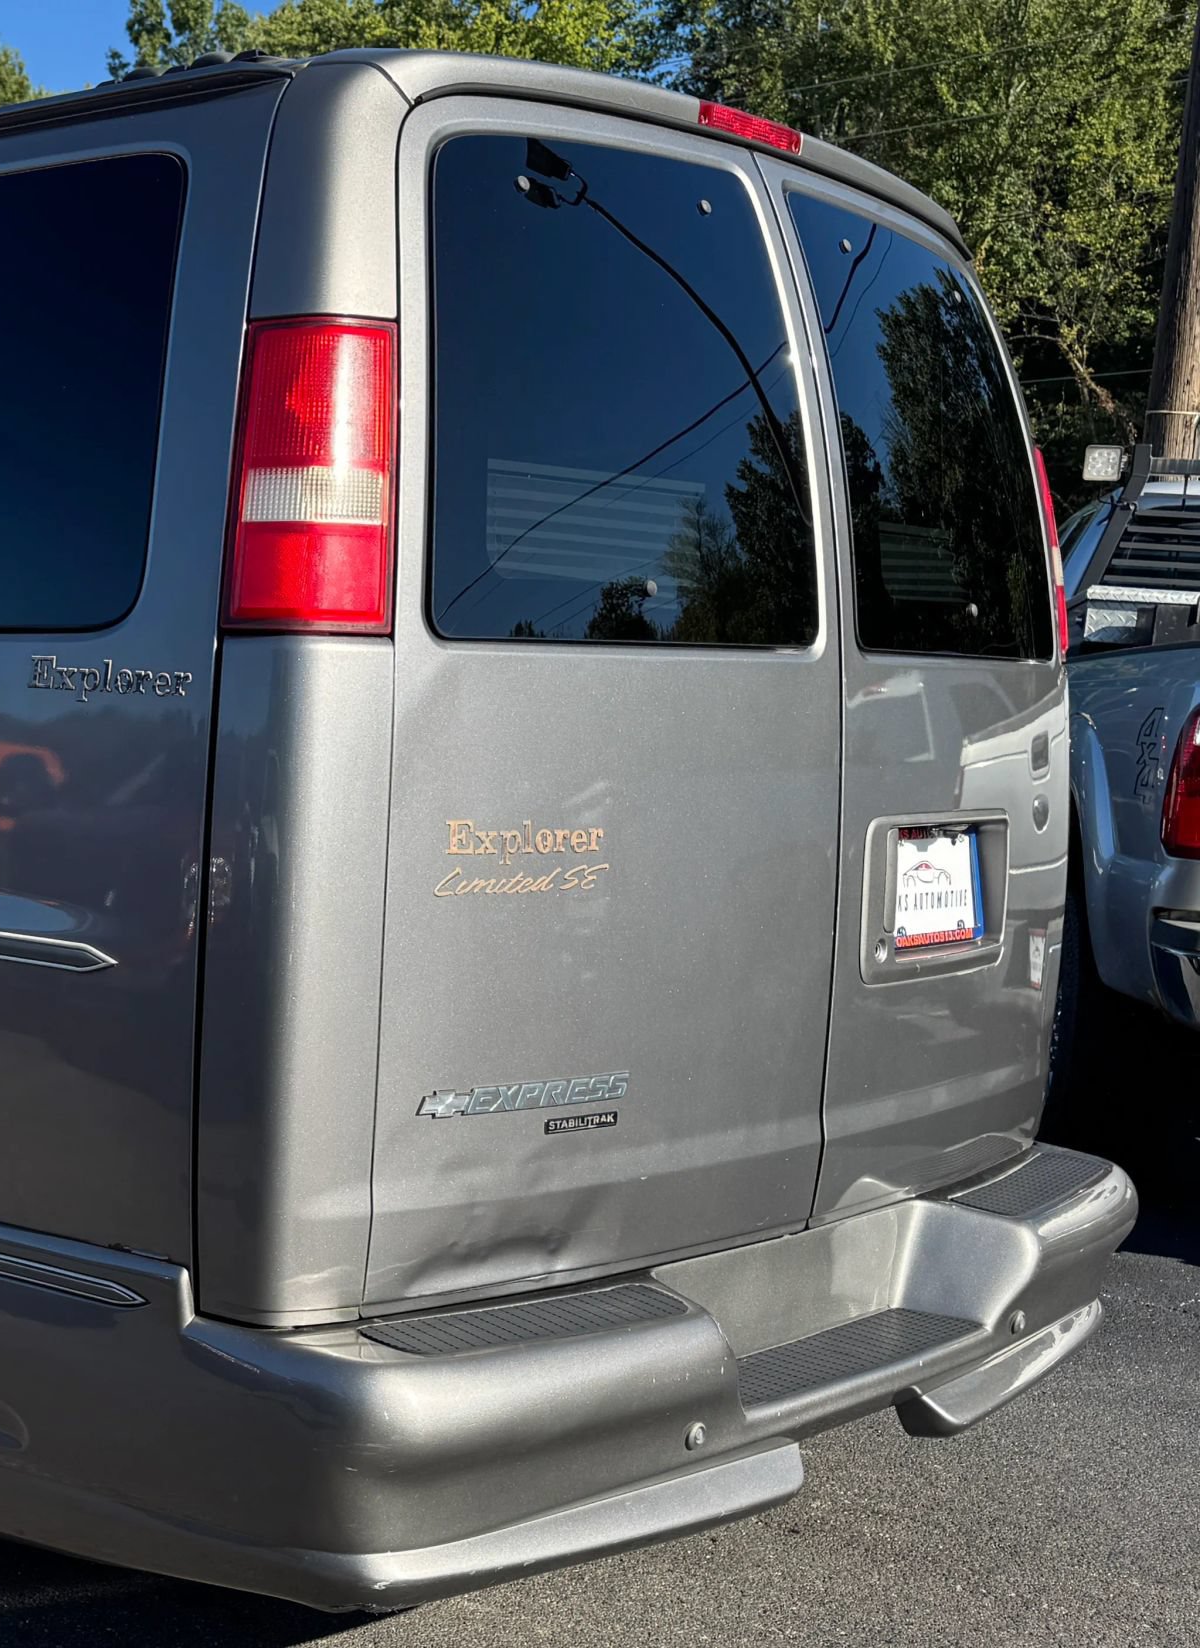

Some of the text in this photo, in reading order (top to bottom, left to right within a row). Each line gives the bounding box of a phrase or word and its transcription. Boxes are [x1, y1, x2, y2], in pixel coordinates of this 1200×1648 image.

[28, 655, 192, 702] Explorer
[445, 819, 604, 865] Explorer
[433, 863, 610, 898] Limited SE
[913, 889, 968, 911] AUTOMOTIVE
[466, 1072, 629, 1115] EXPRESS
[548, 1113, 616, 1131] STABILITRAK
